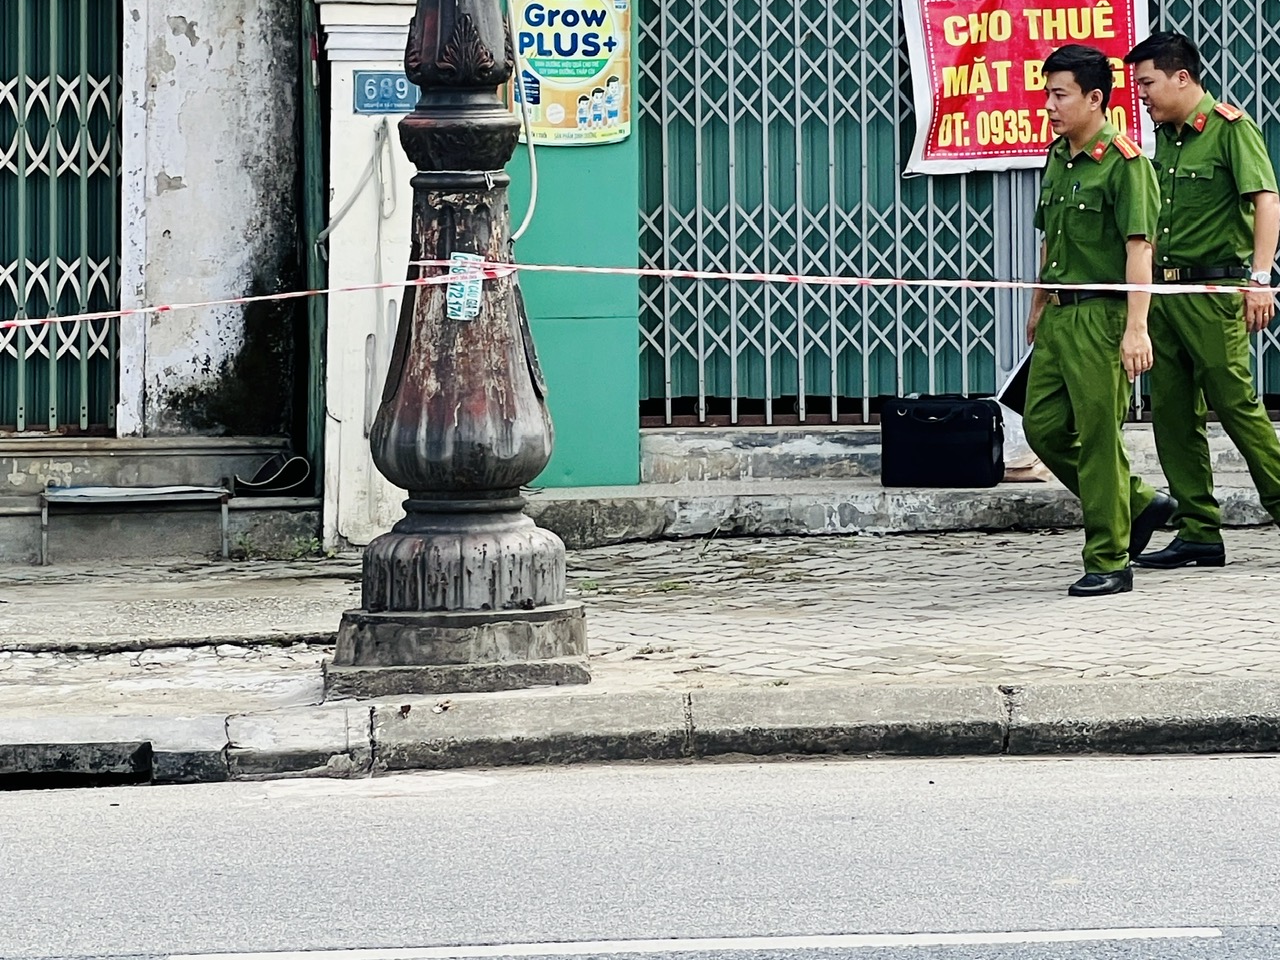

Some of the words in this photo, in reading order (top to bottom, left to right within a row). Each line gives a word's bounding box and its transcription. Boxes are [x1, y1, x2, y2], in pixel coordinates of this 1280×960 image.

[524, 3, 607, 27] Grow
[943, 9, 1011, 46] CHO
[1023, 0, 1115, 39] THUÊ
[518, 31, 617, 57] PLUS+
[942, 55, 1012, 101] MẶT
[1023, 57, 1125, 91] BG
